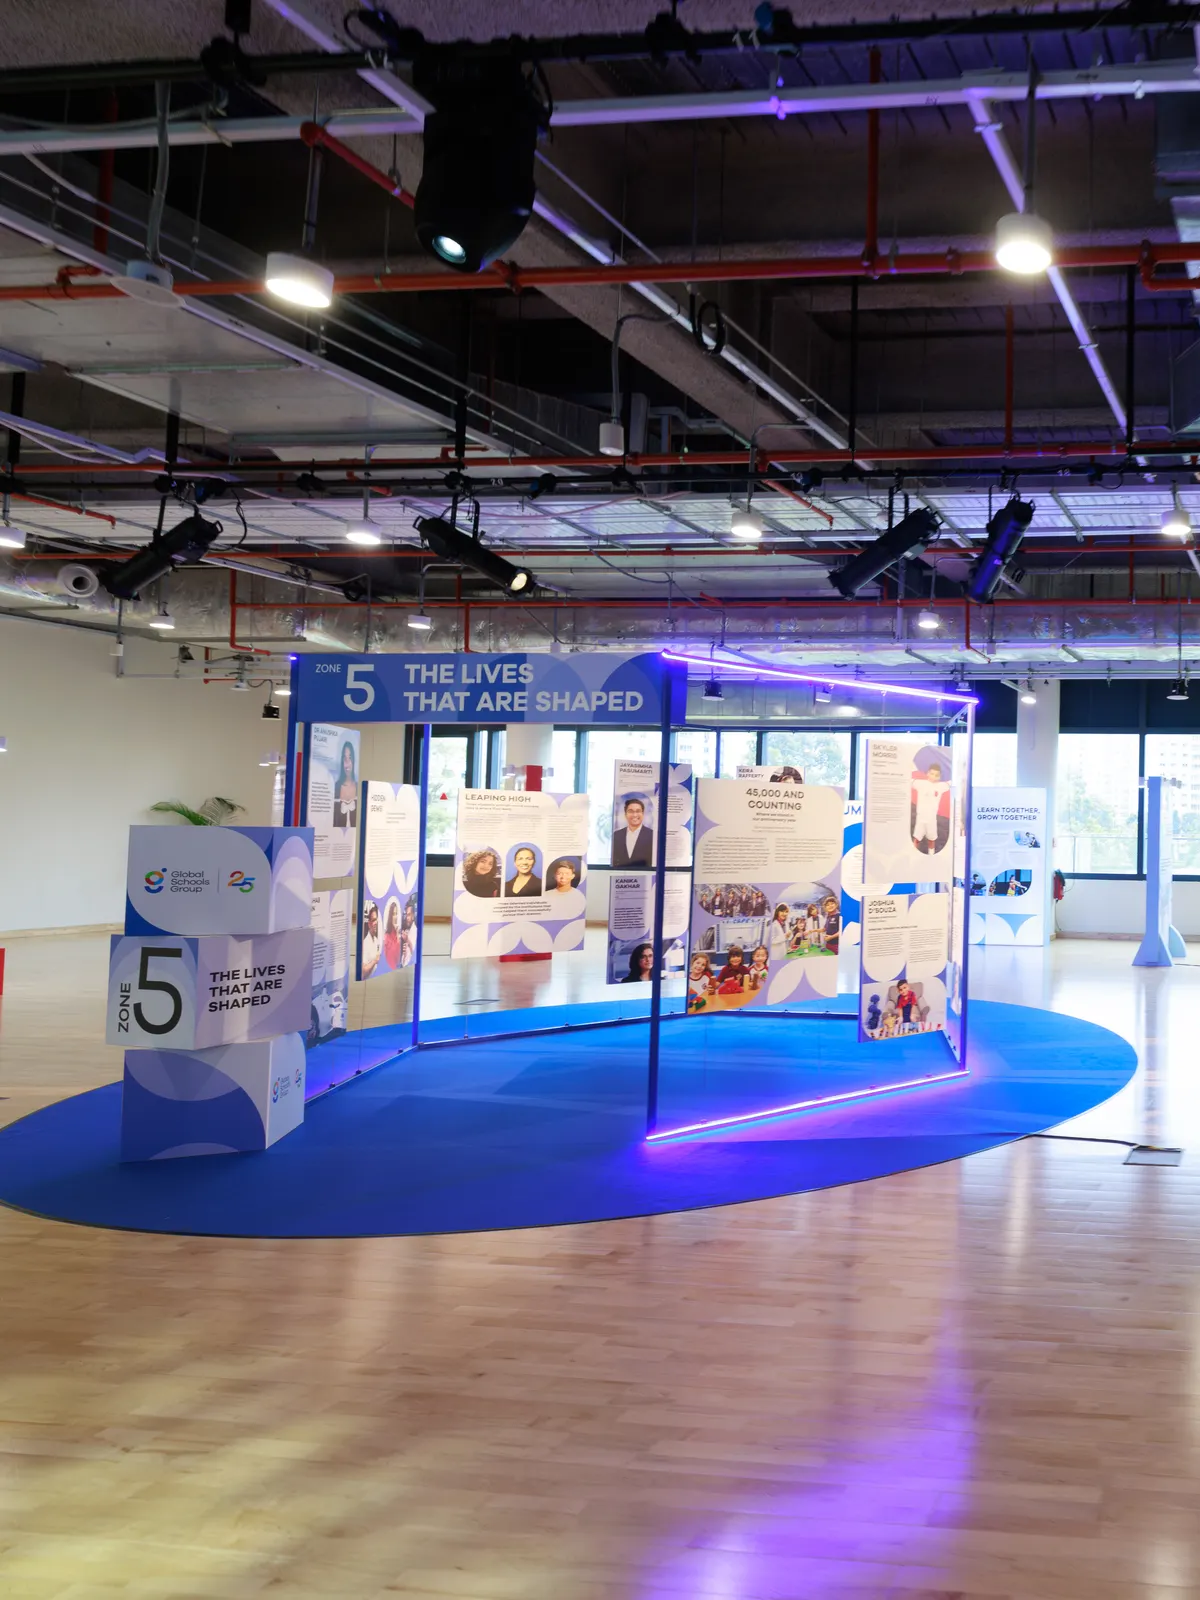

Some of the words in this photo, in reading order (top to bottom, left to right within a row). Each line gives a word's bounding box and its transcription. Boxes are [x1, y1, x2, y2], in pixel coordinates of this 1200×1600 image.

[315, 664, 341, 673] ZONE
[343, 664, 375, 712] 5
[404, 664, 455, 684] THE
[461, 663, 535, 684] LIVES
[403, 692, 471, 712] THAT
[476, 692, 528, 712] ARE
[535, 691, 644, 712] SHAPED
[465, 794, 507, 802] LEAPING
[508, 795, 531, 803] HIGH
[745, 788, 780, 799] 45,000
[783, 790, 805, 799] AND
[747, 800, 802, 811] COUNTING
[170, 870, 204, 878] Global
[170, 878, 210, 886] Schools
[227, 870, 256, 893] 25
[170, 886, 203, 894] Group
[210, 970, 240, 983] THE
[244, 964, 285, 979] LIVES
[118, 983, 131, 1033] ZONE
[133, 947, 182, 1035] 5
[209, 983, 250, 998] THAT
[253, 979, 283, 992] ARE
[208, 994, 271, 1012] SHAPED
